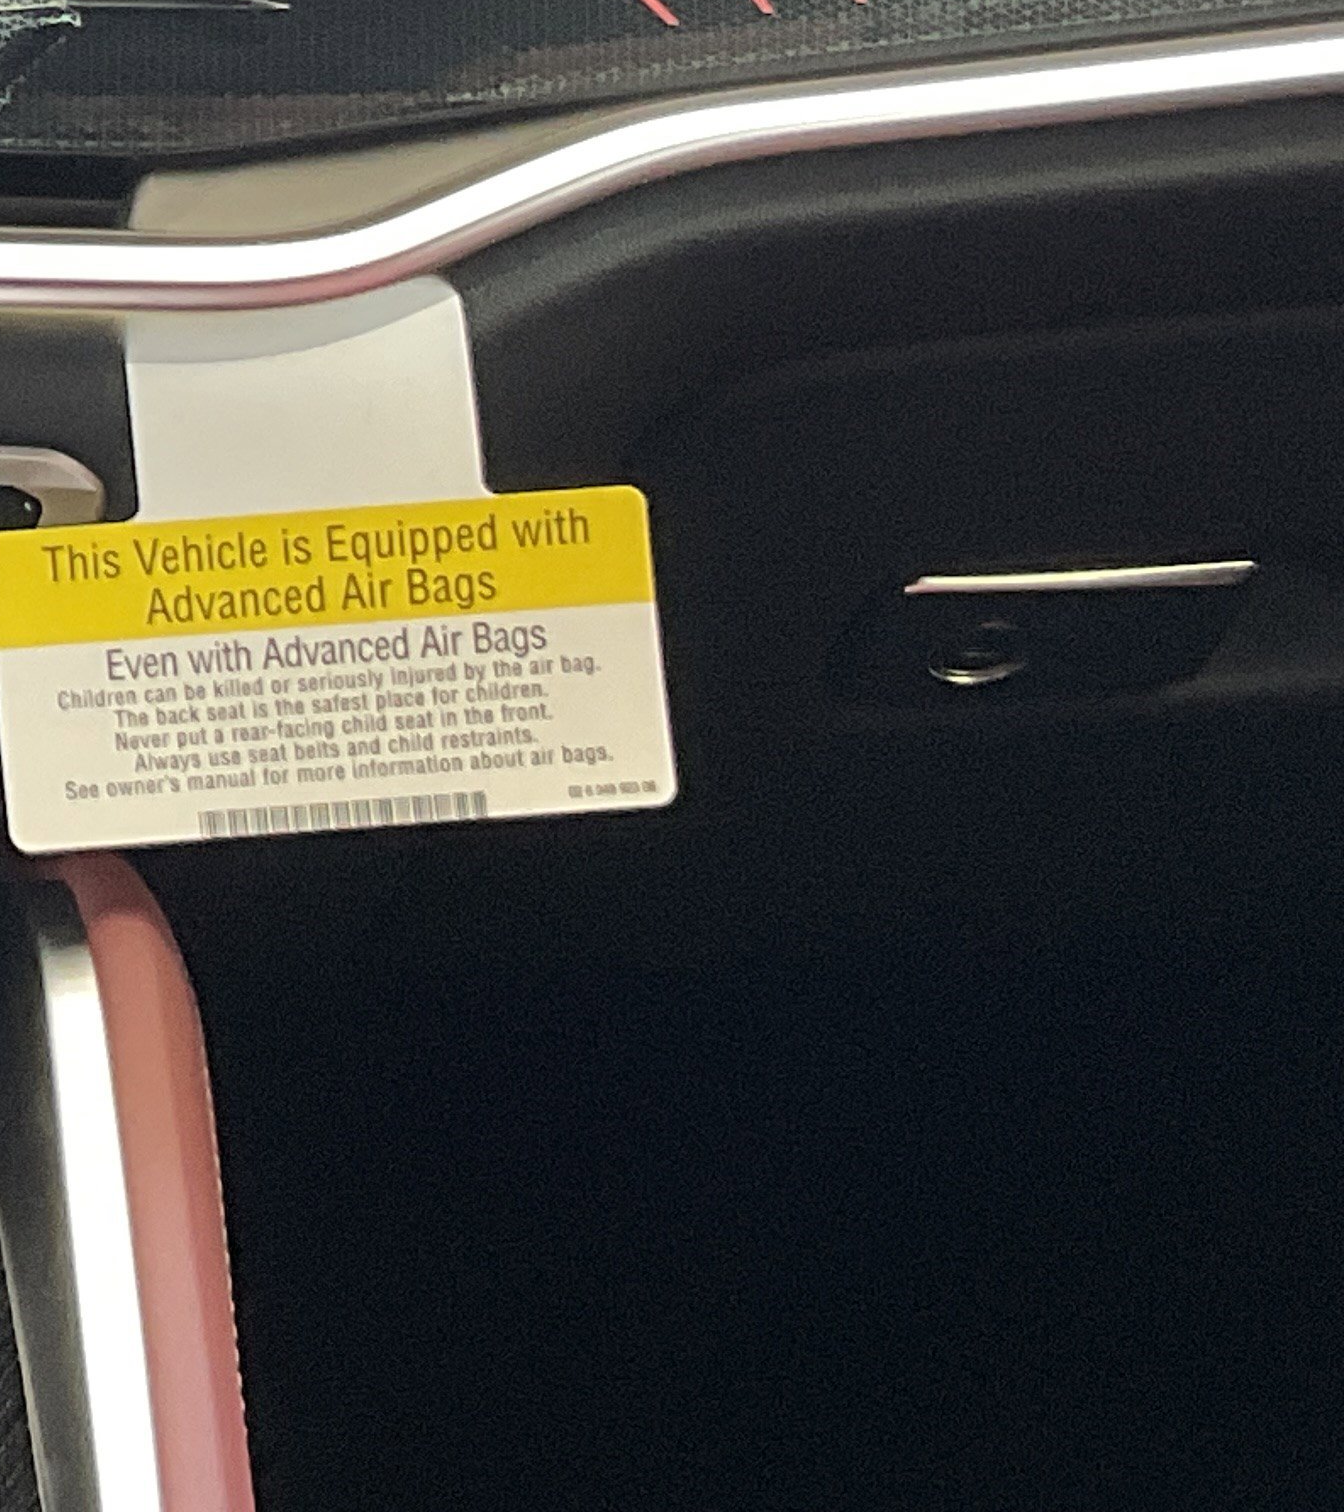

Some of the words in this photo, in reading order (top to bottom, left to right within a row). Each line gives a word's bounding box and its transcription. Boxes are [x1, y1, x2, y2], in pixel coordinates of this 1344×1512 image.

[41, 542, 122, 583] This
[132, 531, 269, 576] Vehicle
[280, 528, 313, 566] is
[326, 513, 498, 568] Equipped
[511, 507, 591, 548] with
[146, 574, 327, 626] Advanced
[341, 571, 393, 612] Air
[406, 567, 498, 610] Bags
[106, 647, 179, 682] Even
[187, 639, 253, 676] with
[262, 626, 410, 671] Advanced
[420, 624, 463, 659] Air
[471, 621, 548, 658] Bags
[57, 689, 138, 712] Children
[144, 686, 178, 704] can
[184, 682, 207, 701] be
[213, 676, 263, 698] killed
[270, 678, 290, 695] or
[297, 669, 384, 693] seriously
[390, 662, 457, 688] injured
[463, 662, 487, 683] by
[493, 659, 523, 678] the
[529, 656, 554, 675] air
[560, 654, 602, 676] bag.
[114, 709, 149, 728] The
[155, 705, 200, 727] back
[206, 701, 246, 722] seat
[252, 700, 269, 719] is
[274, 698, 305, 717] the
[311, 692, 369, 714] safest
[375, 691, 426, 713] place
[431, 686, 459, 706] for
[464, 682, 550, 703] children.
[114, 731, 170, 751] Never
[177, 727, 209, 750] put
[214, 728, 225, 744] a
[231, 719, 335, 743] rear-facing
[341, 713, 388, 735] child
[394, 710, 435, 731] seat
[439, 708, 459, 728] in
[463, 705, 494, 725] the
[500, 702, 554, 723] front.
[134, 752, 202, 773] Always
[207, 749, 242, 767] use
[247, 743, 288, 764] seat
[294, 740, 341, 761] belts
[346, 736, 381, 757] and
[387, 732, 434, 754] child
[440, 726, 539, 750] restraints.
[64, 780, 100, 800] See
[105, 774, 181, 798] owner's
[186, 768, 257, 791] manual
[262, 767, 289, 786] for
[296, 762, 346, 784] more
[352, 753, 463, 780] information
[469, 748, 525, 771] about
[530, 746, 555, 767] air
[561, 744, 616, 766] bags.
